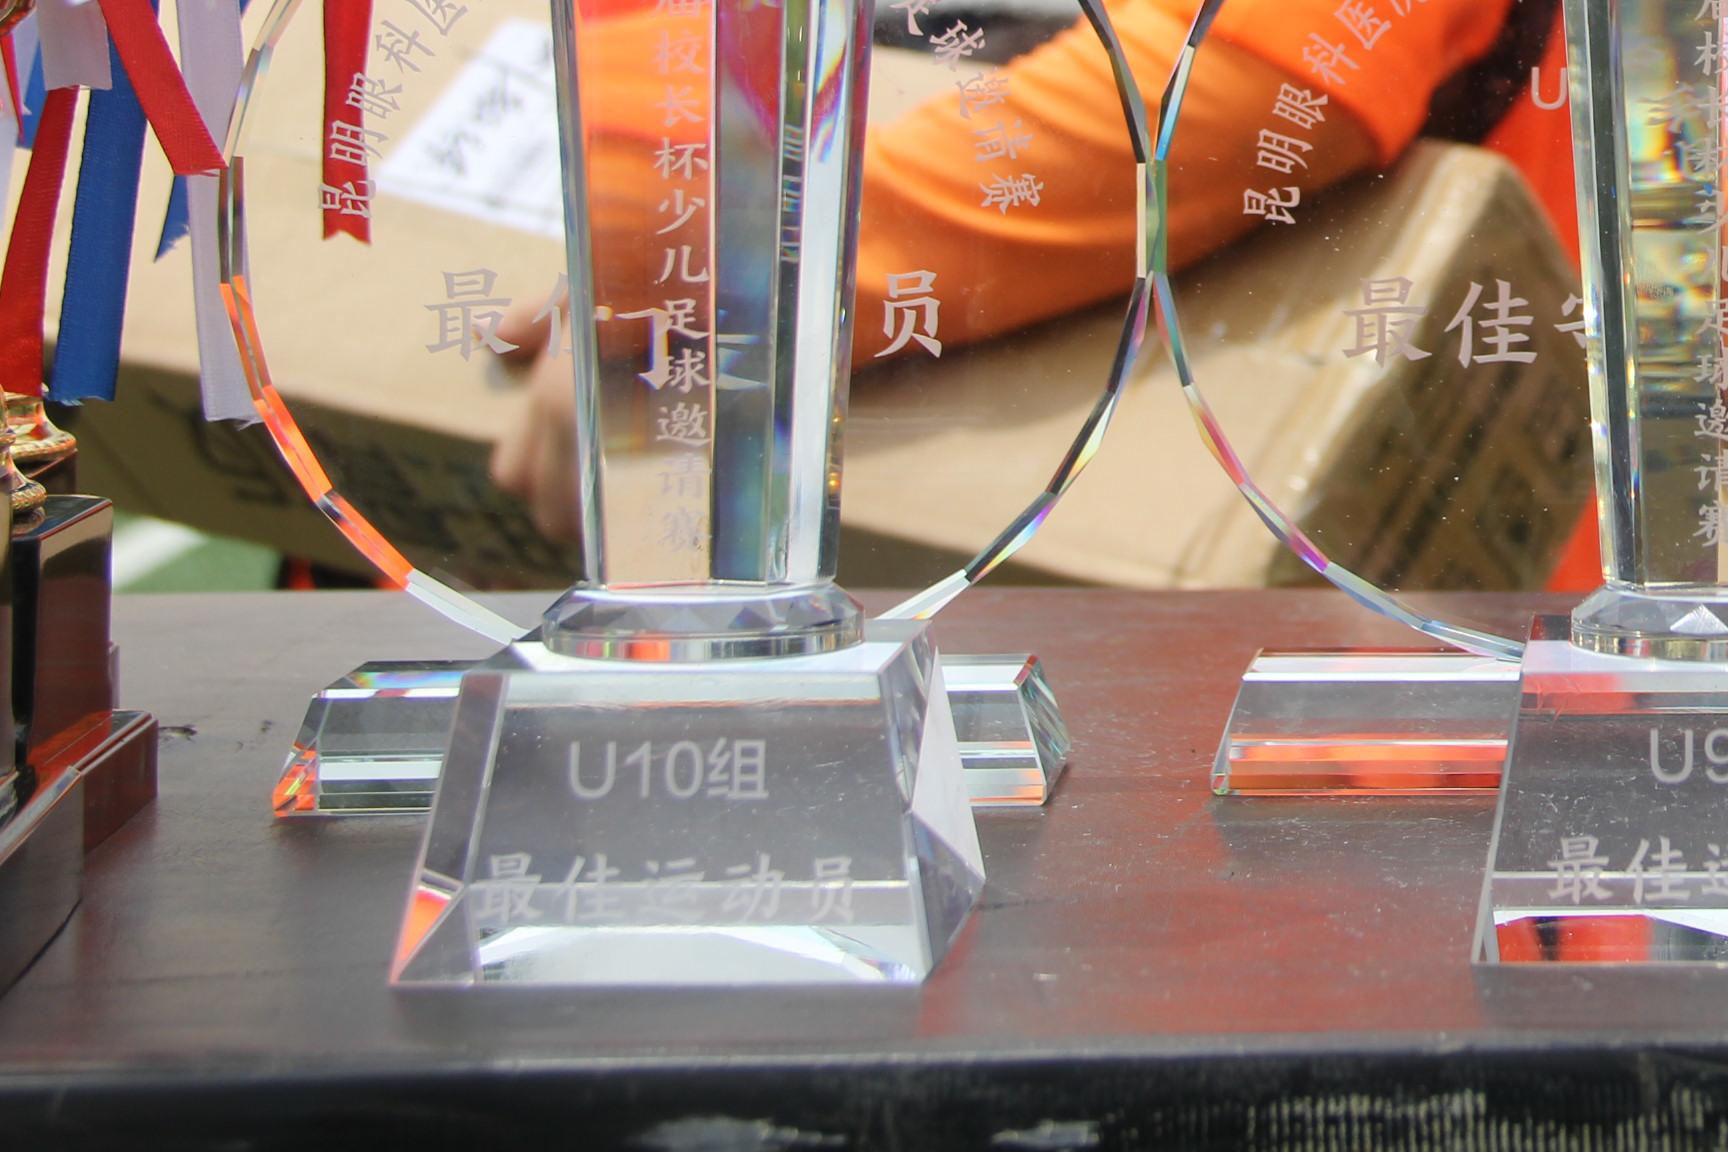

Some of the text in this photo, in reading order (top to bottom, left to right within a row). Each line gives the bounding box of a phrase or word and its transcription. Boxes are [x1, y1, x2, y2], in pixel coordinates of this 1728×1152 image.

[873, 269, 942, 358] 员
[568, 736, 770, 802] U10组
[475, 851, 857, 924] 最佳运动员
